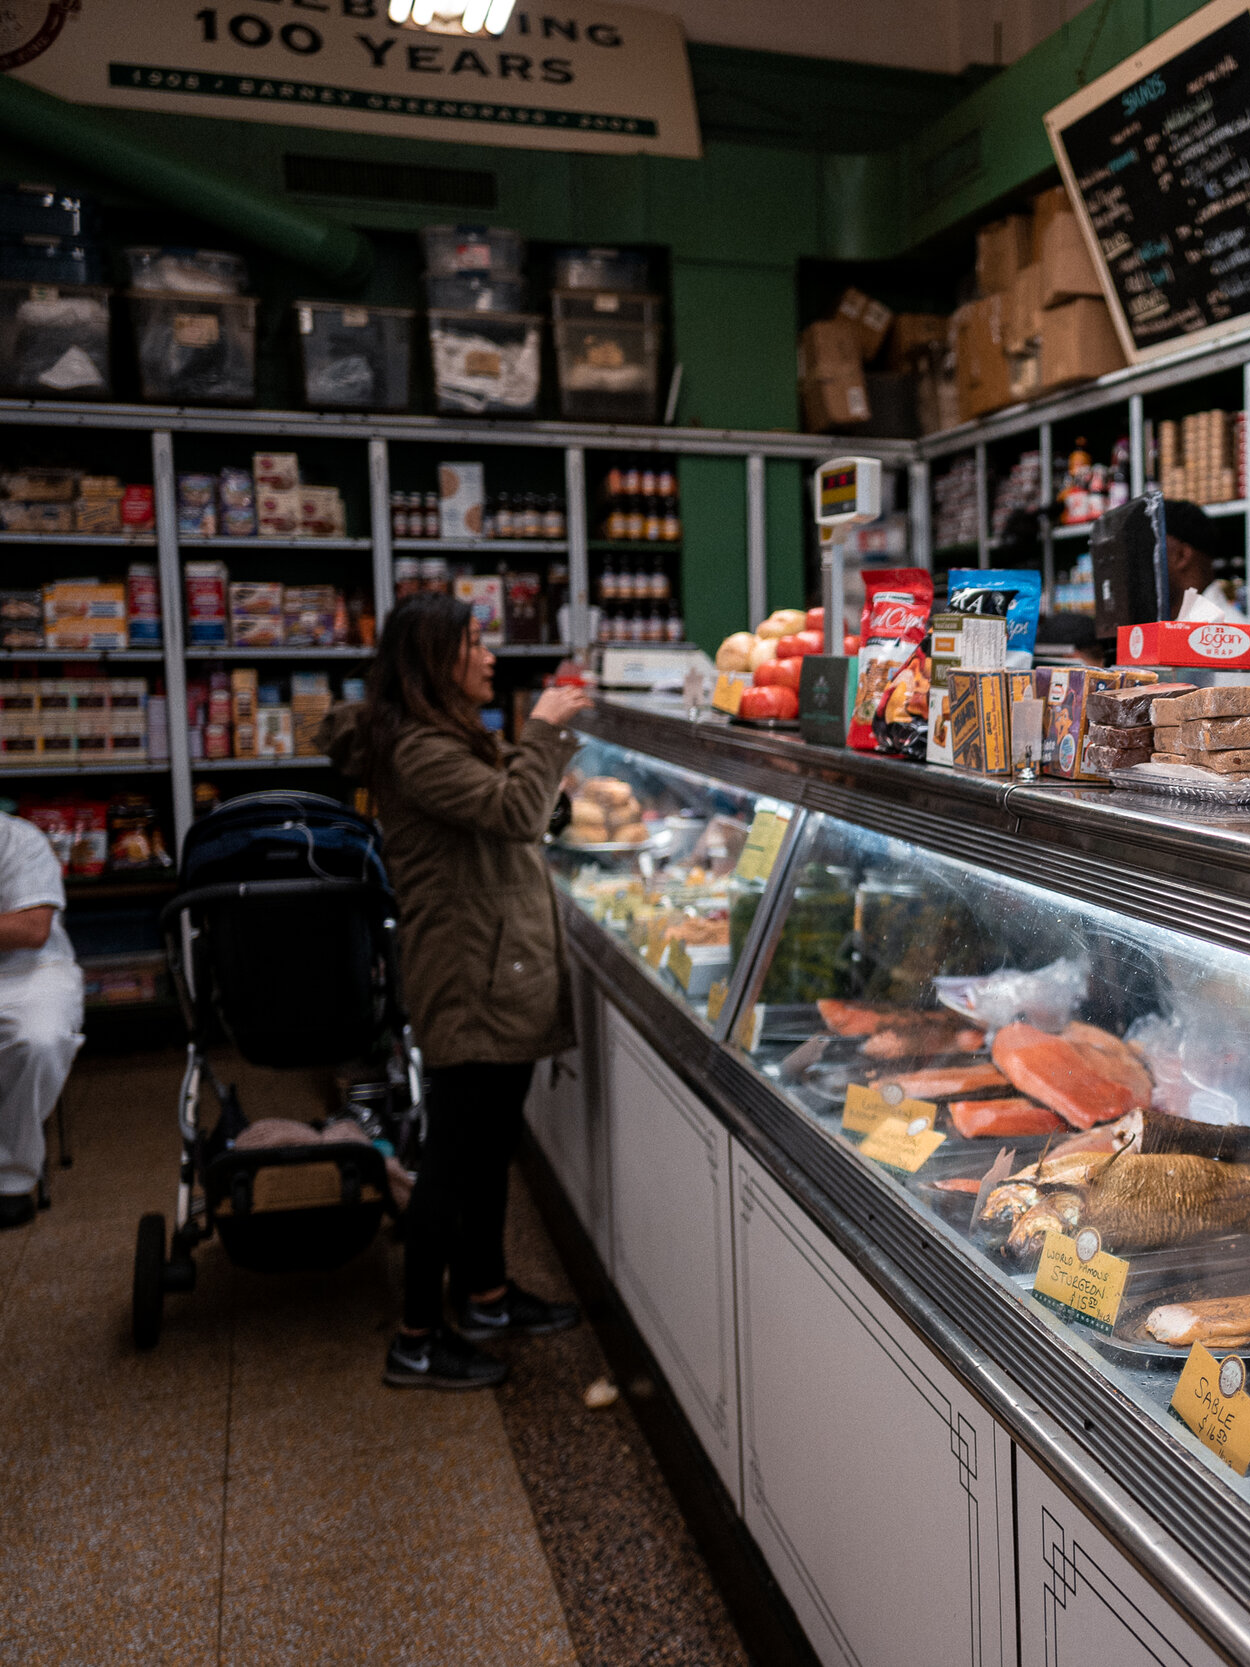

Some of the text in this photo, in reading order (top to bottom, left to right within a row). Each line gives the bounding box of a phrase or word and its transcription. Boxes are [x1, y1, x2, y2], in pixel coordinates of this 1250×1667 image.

[196, 8, 574, 85] 100 YEARS
[1198, 627, 1242, 649] Logan
[1046, 1248, 1110, 1282] WORLD FAMOUS
[1050, 1265, 1106, 1300] STURGEON
[1194, 1376, 1236, 1431] SABLE
